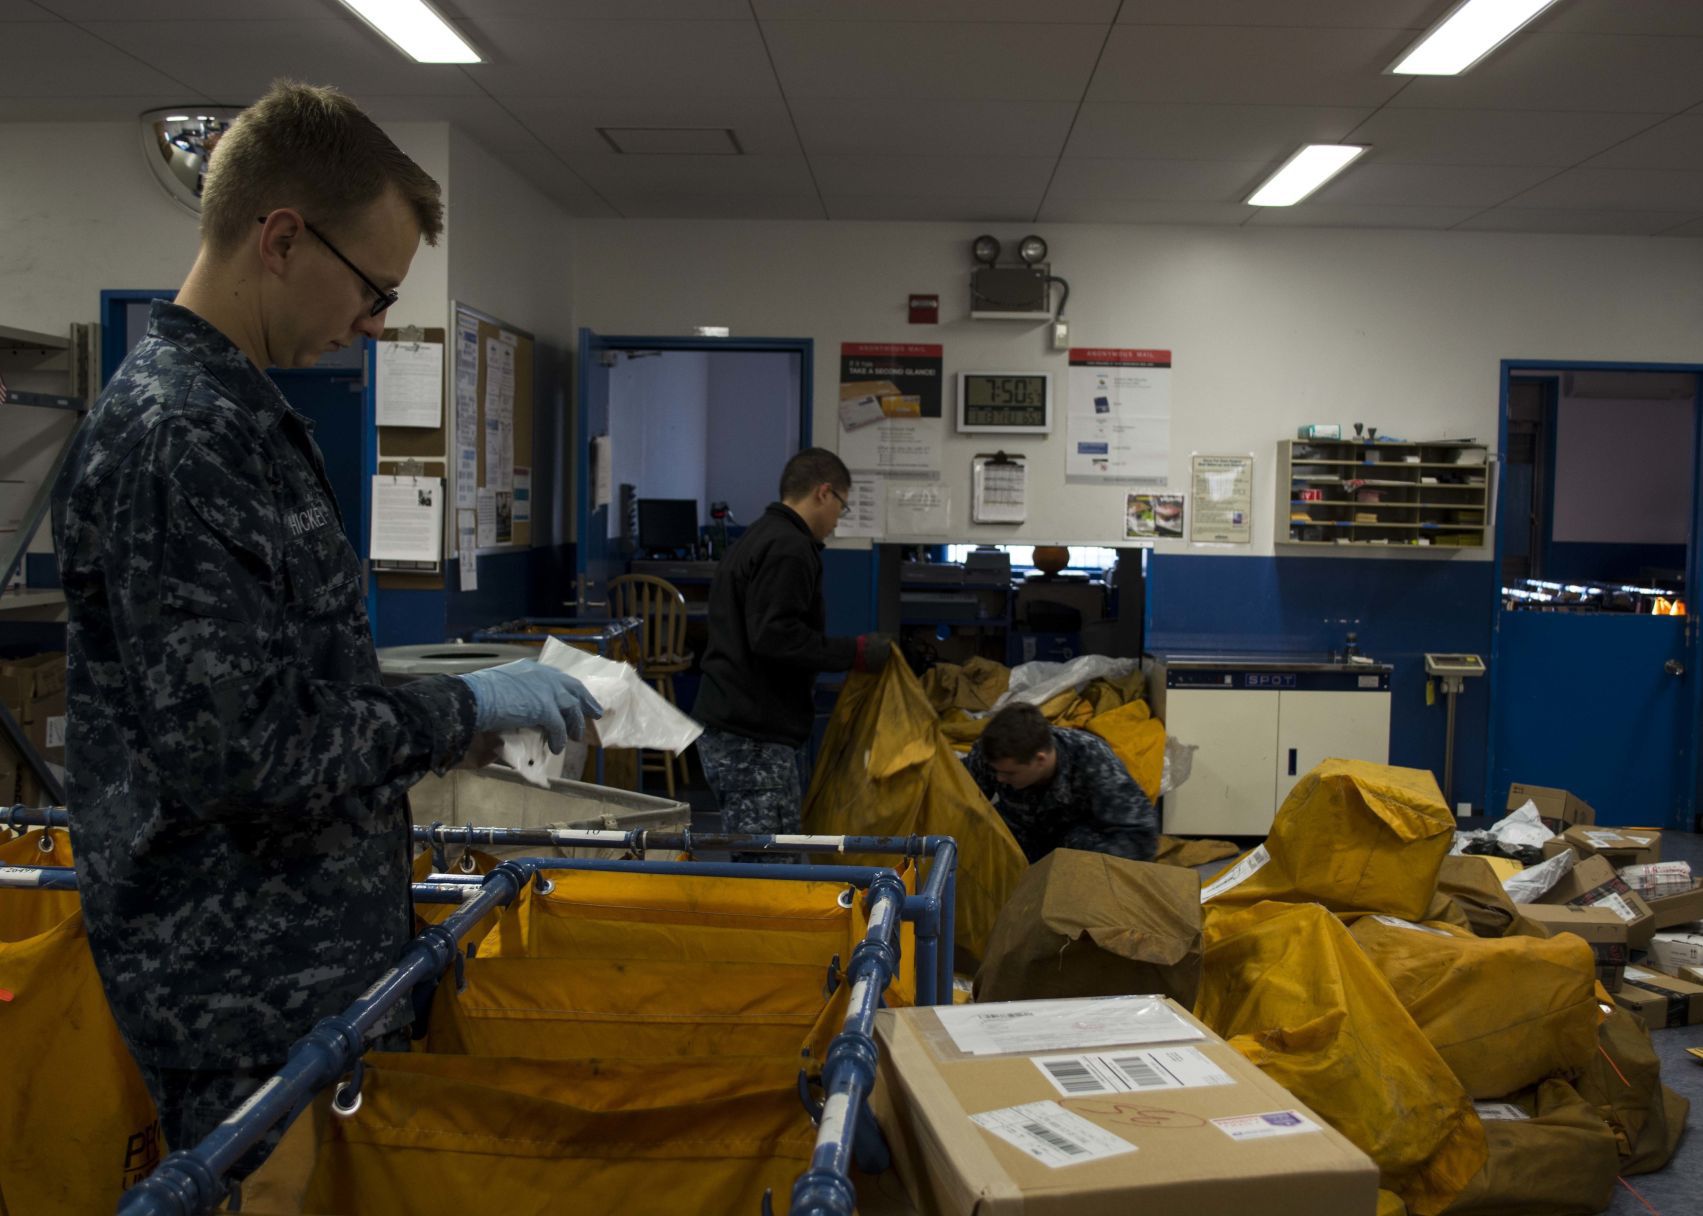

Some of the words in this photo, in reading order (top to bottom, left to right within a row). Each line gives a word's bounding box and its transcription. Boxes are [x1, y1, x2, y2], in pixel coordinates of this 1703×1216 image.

[1086, 350, 1133, 358] ANONYMOUS
[1136, 351, 1155, 359] MAIL
[848, 367, 866, 376] TAKE
[874, 367, 904, 376] SECOND
[904, 368, 937, 377] GLANCE!
[1247, 674, 1294, 686] SPOT
